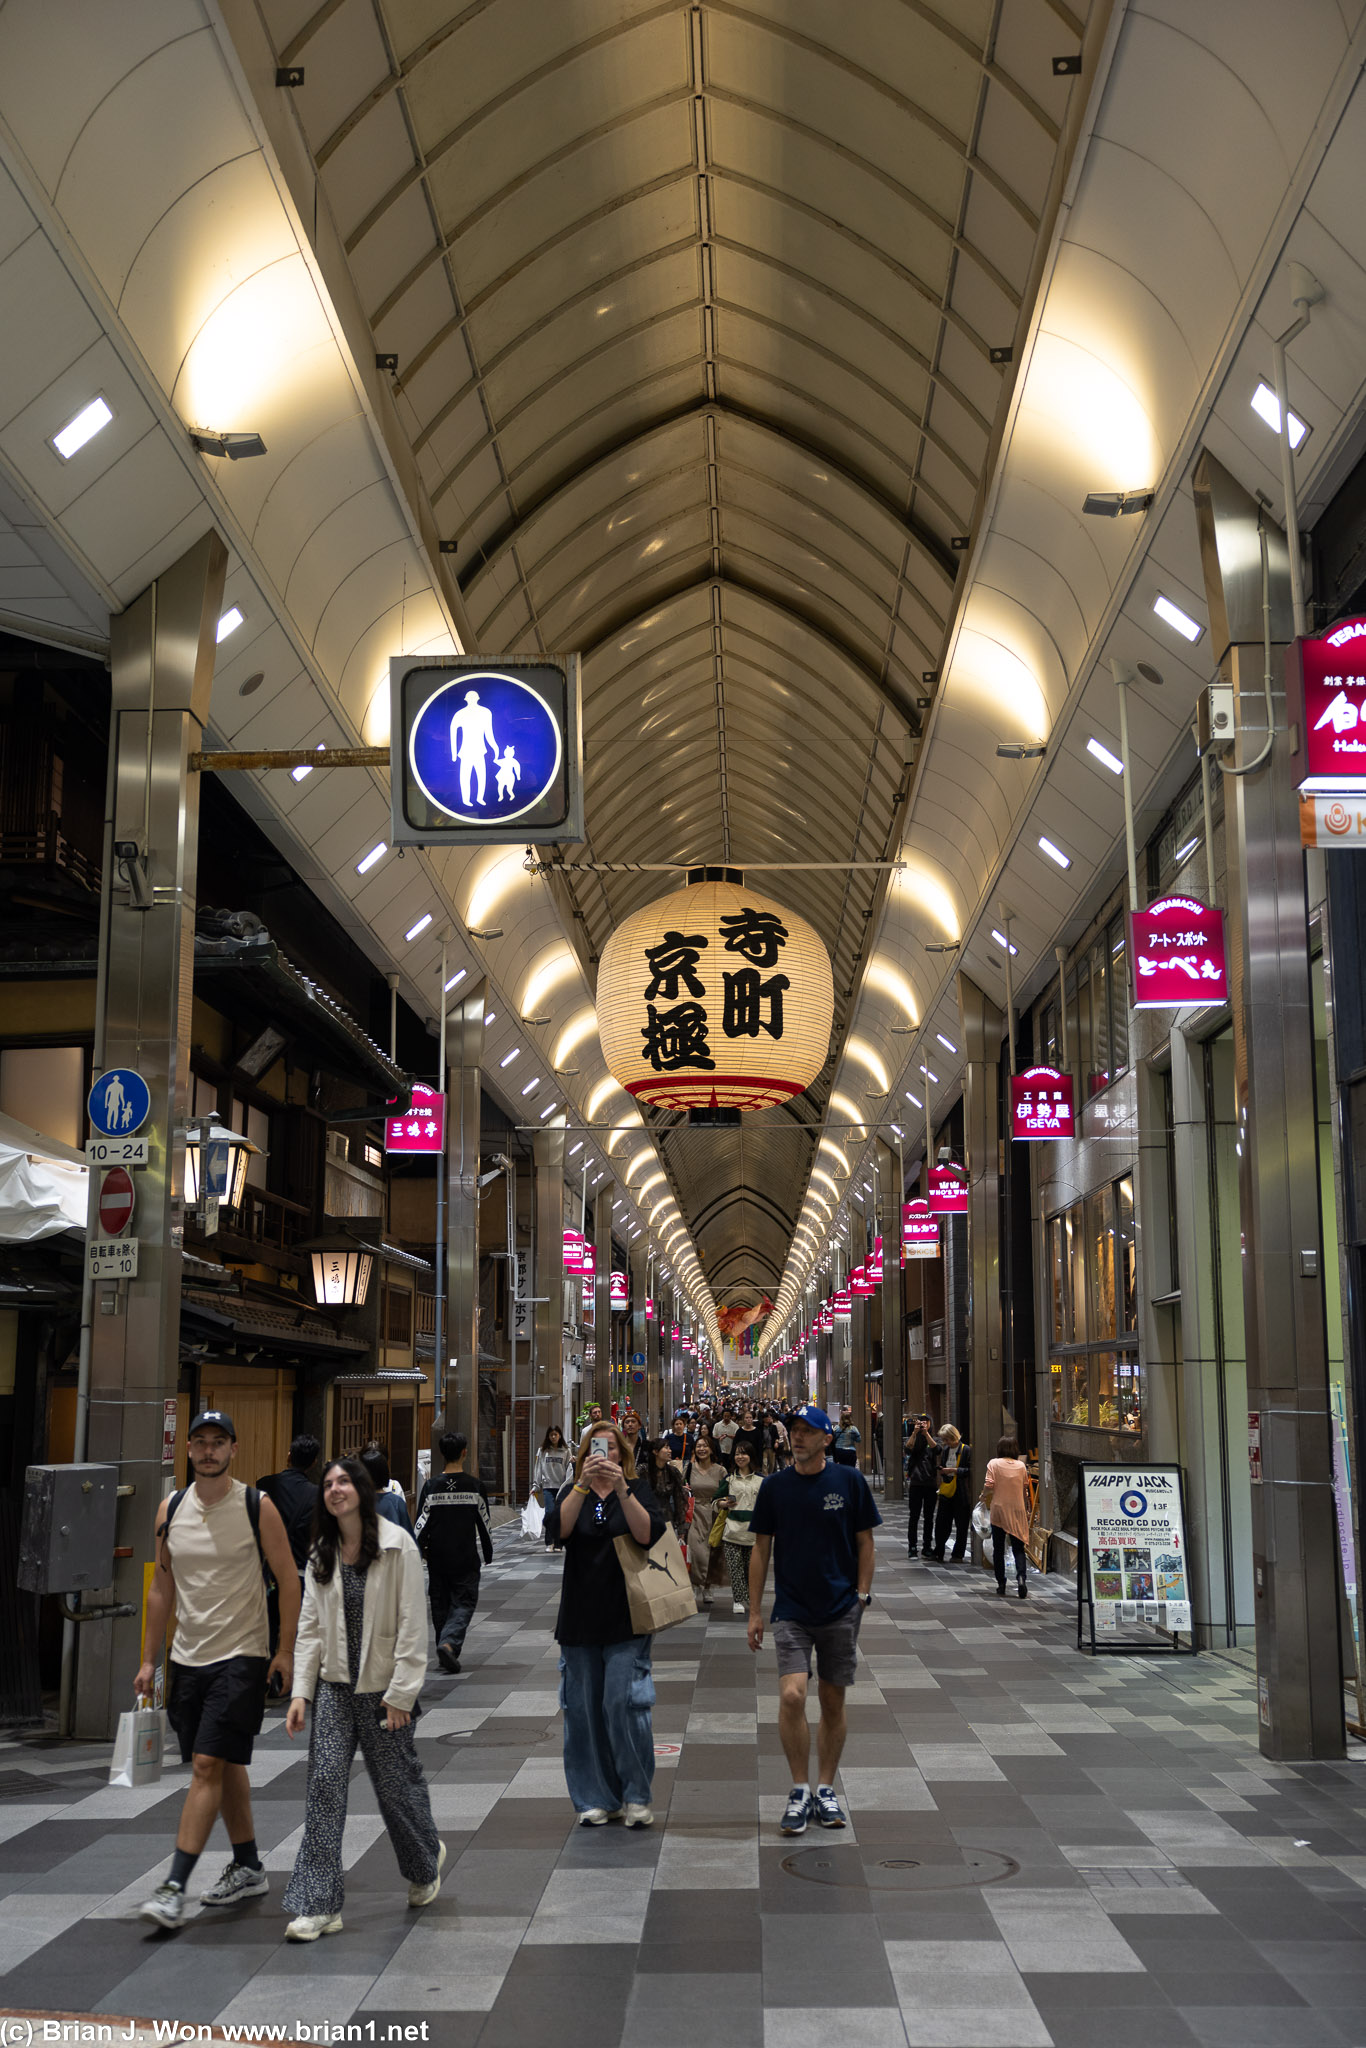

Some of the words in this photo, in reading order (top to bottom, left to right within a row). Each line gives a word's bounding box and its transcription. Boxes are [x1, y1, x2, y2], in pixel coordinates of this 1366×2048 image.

[1148, 898, 1203, 916] TERAMACHI
[1148, 931, 1208, 947] アート・スポット
[718, 907, 790, 1041] 寺町
[640, 930, 716, 1072] 京極
[1023, 1067, 1060, 1080] TERAMACHI
[1016, 1103, 1070, 1119] 伊勢屋
[1026, 1118, 1060, 1129] ISEYA
[90, 1244, 136, 1259] 自転車を除く
[1088, 1474, 1132, 1487] HAPPY
[1136, 1475, 1173, 1488] JACK
[1097, 1518, 1134, 1526] RECORD
[1151, 1519, 1170, 1527] DVD
